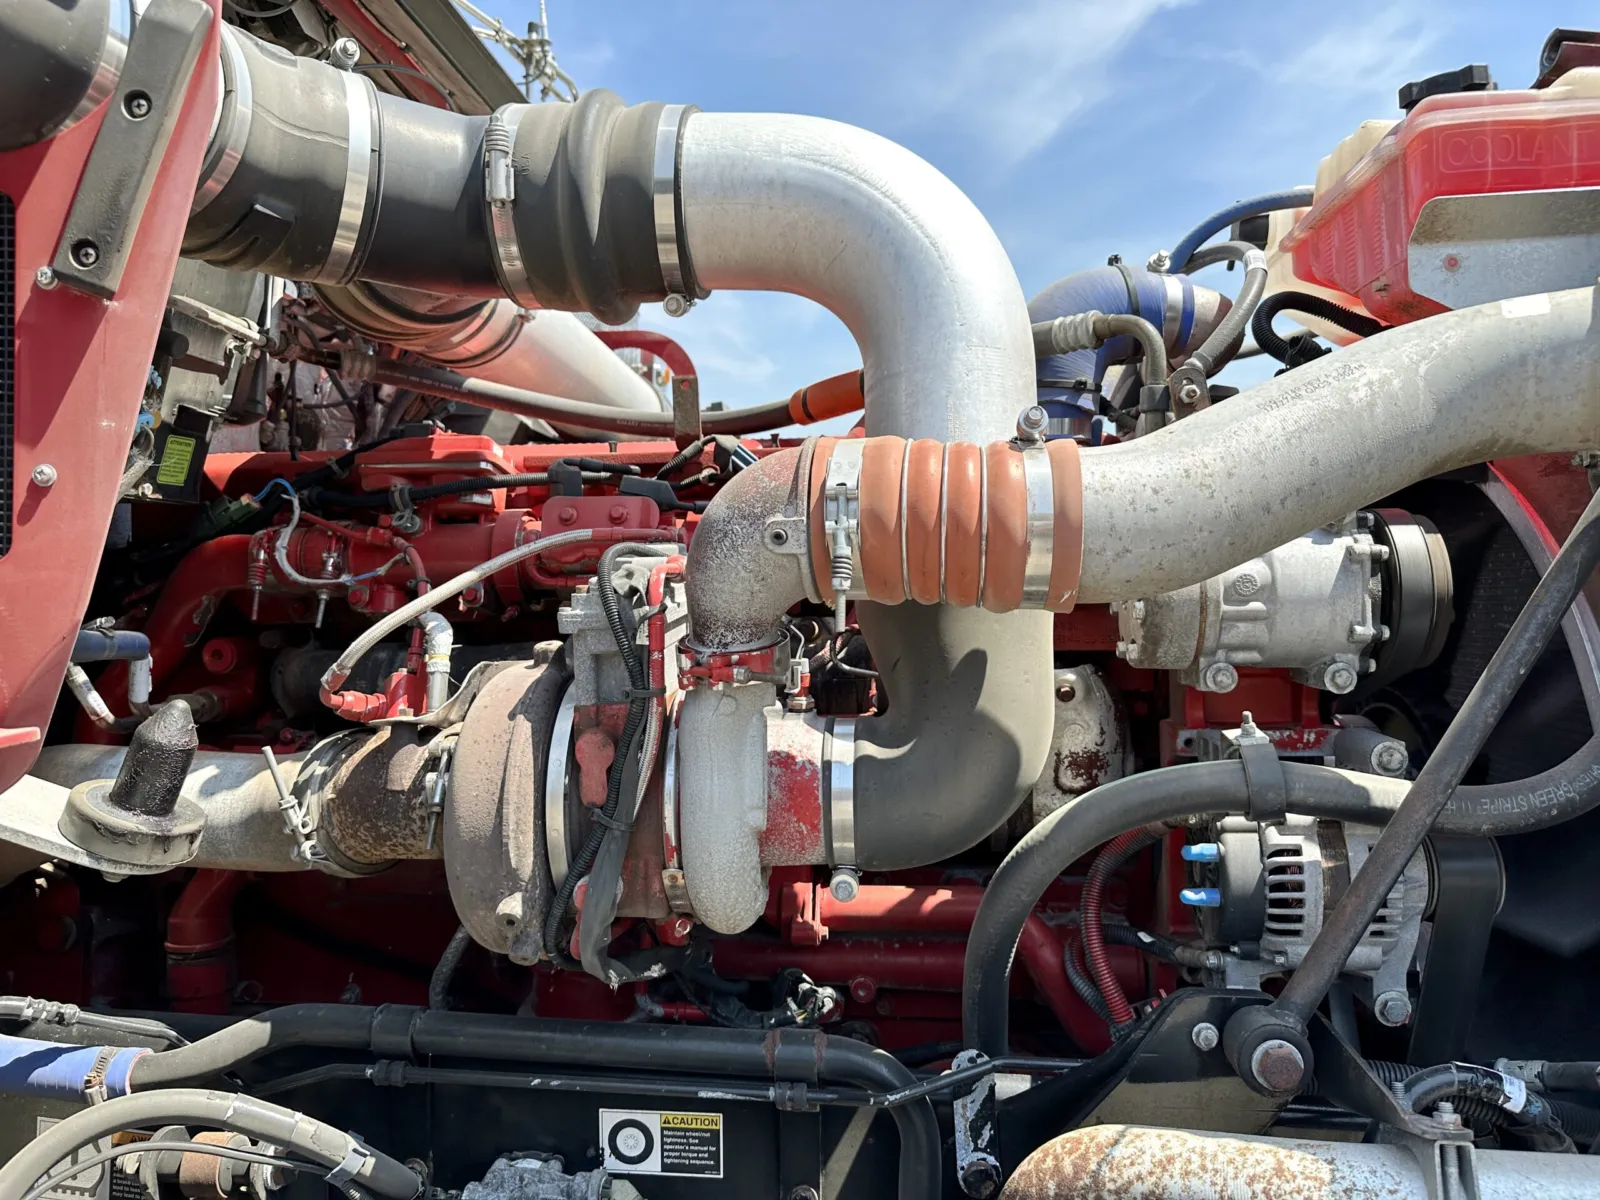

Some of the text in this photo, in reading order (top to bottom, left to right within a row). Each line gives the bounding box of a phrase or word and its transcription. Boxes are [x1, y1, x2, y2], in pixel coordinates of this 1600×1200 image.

[1447, 129, 1597, 165] COOLANT
[1529, 781, 1575, 808] GREEN
[672, 1116, 718, 1126] CAUTION
